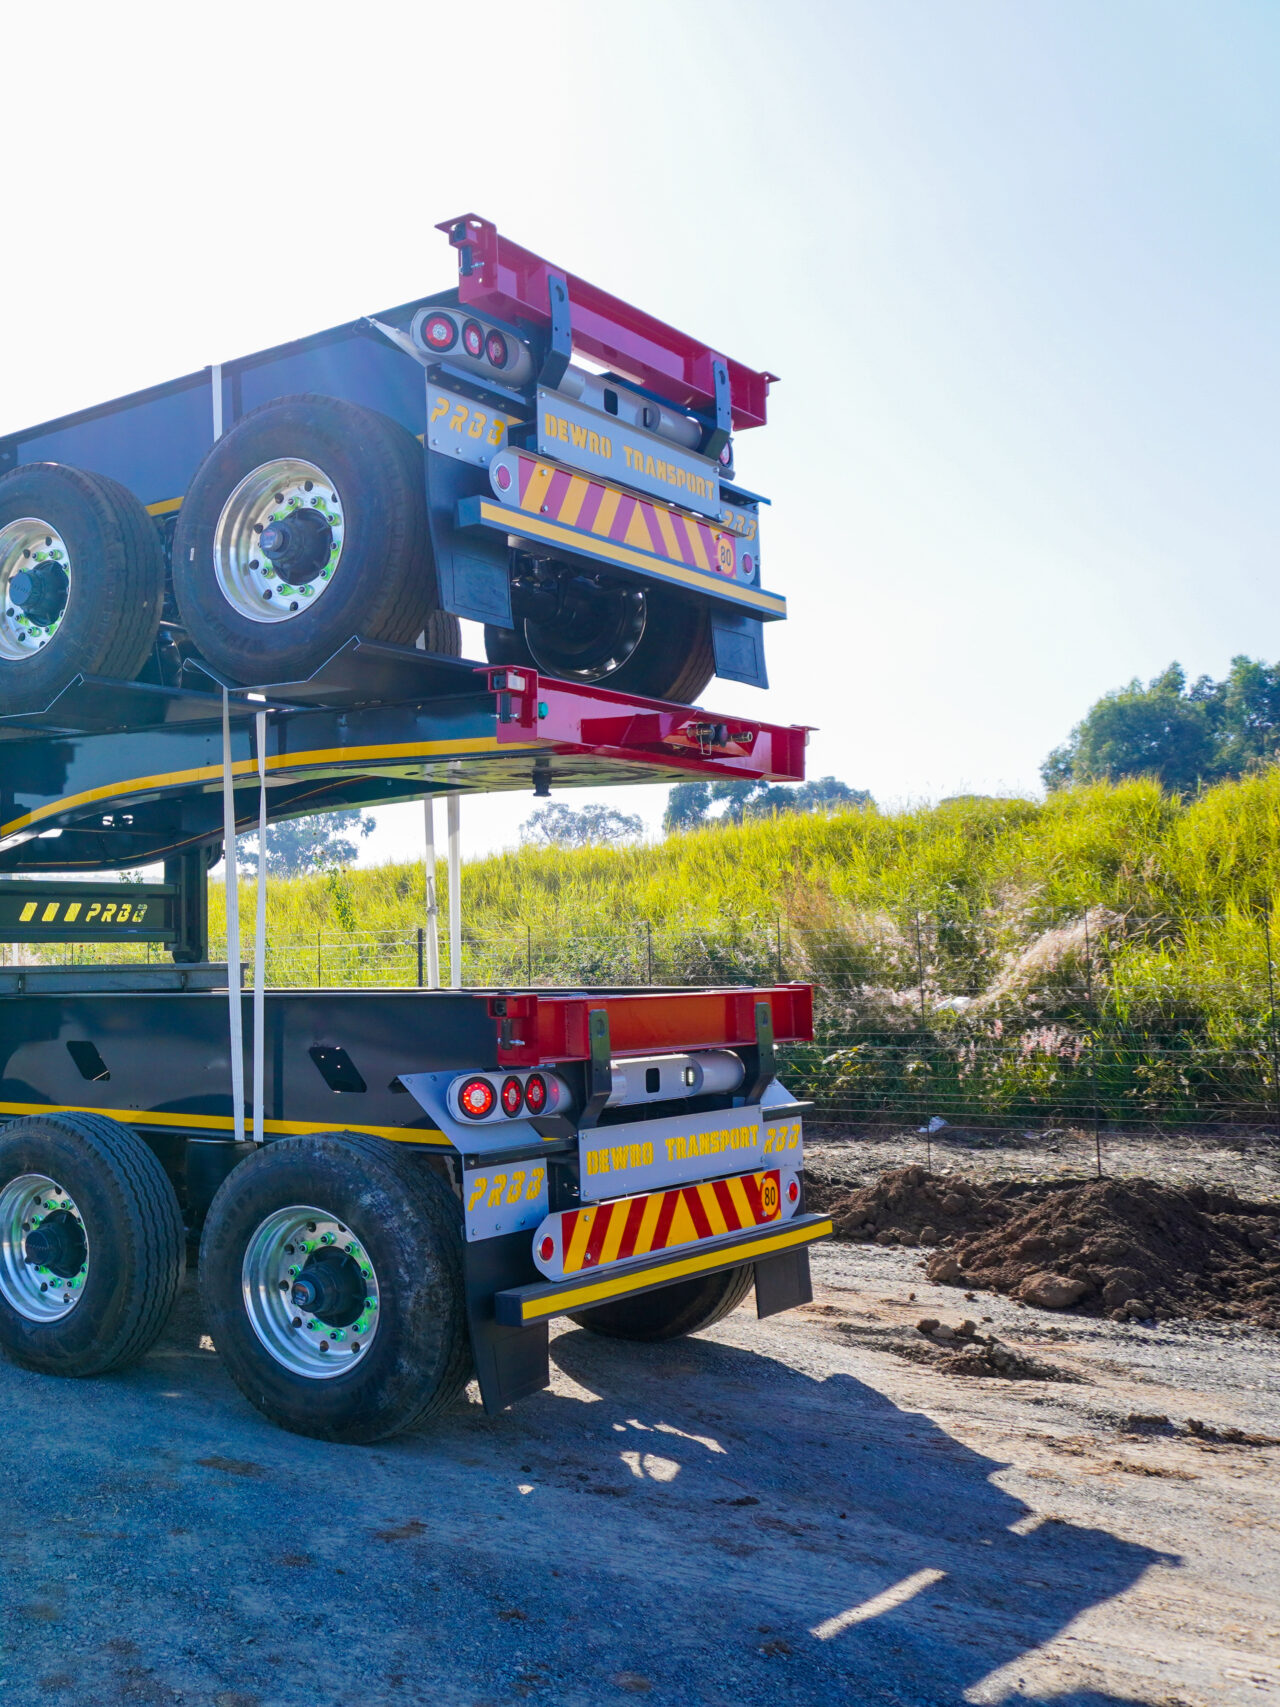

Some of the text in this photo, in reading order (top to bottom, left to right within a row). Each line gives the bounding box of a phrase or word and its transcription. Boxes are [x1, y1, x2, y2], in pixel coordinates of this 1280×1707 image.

[431, 397, 505, 446] PRBB
[544, 412, 716, 500] DEWRO TRANSPORT
[720, 545, 732, 568] 80
[85, 902, 148, 922] PRBB
[586, 1124, 759, 1176] DEWRO TRANSPORT
[763, 1123, 801, 1154] RBB
[467, 1167, 545, 1212] PRBB
[764, 1185, 776, 1207] 80
